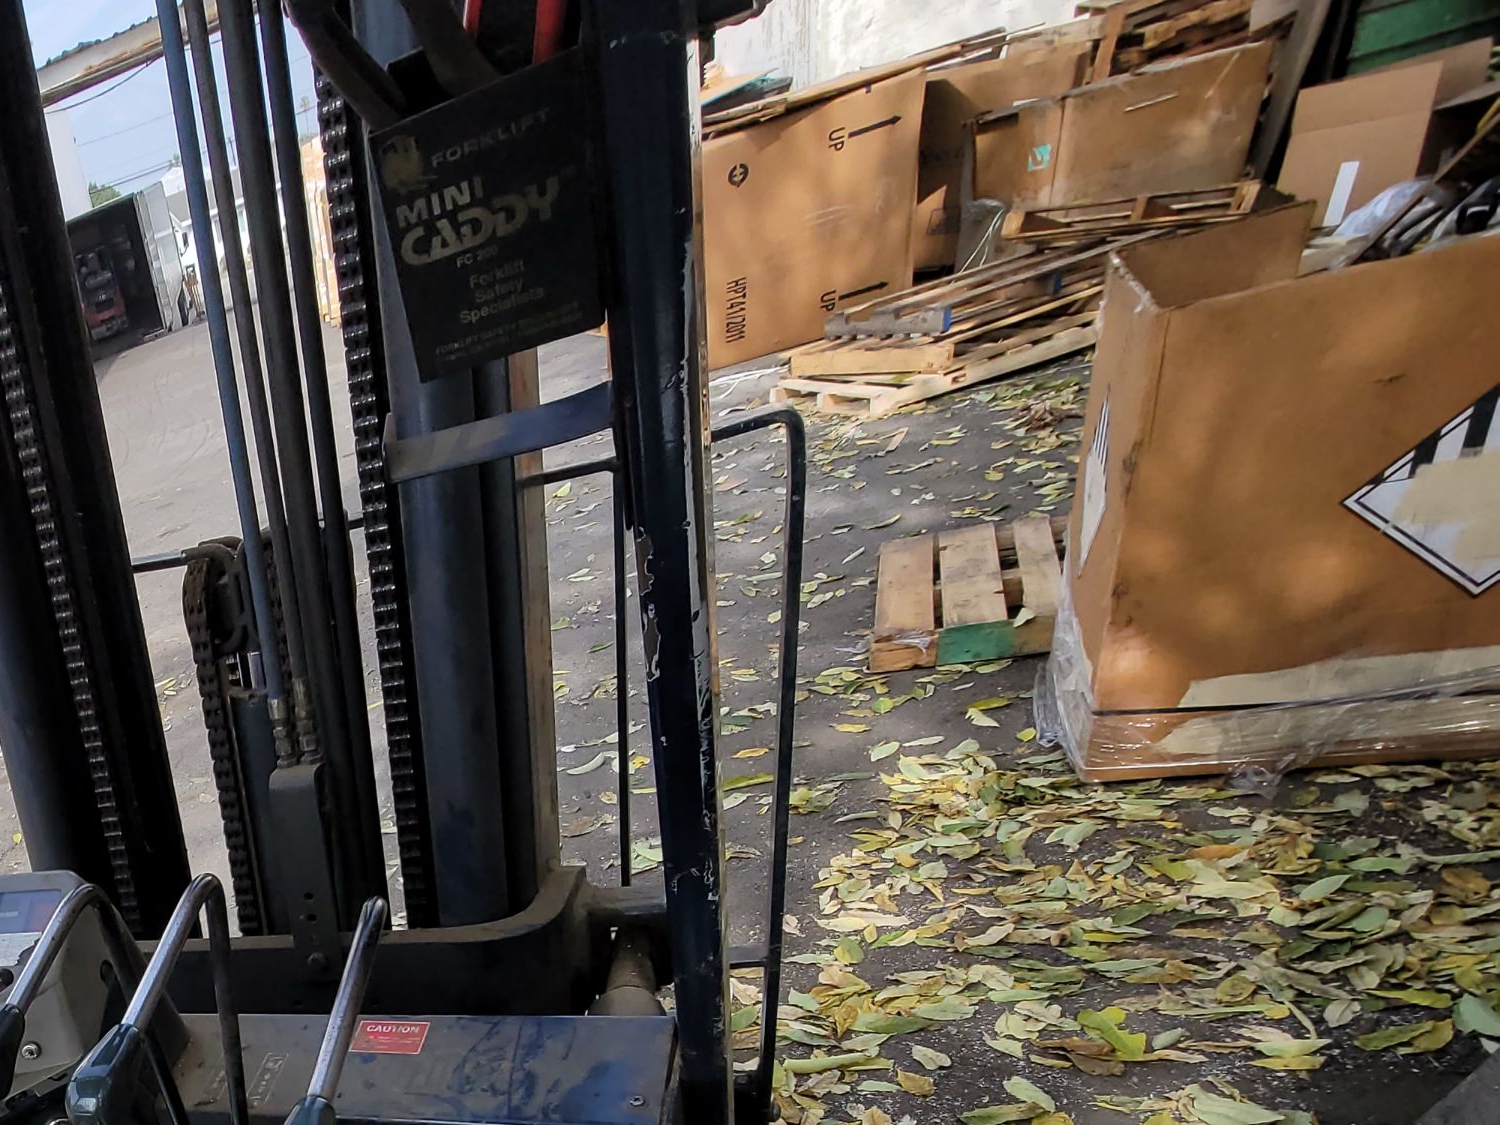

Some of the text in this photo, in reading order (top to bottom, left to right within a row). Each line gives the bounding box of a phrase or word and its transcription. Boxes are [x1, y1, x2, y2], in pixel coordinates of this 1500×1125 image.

[431, 107, 550, 168] FORKLIFT
[828, 127, 845, 152] UP
[396, 176, 484, 229] MINI
[401, 175, 561, 267] CADDY
[725, 276, 748, 344] HPT41/2011
[820, 289, 836, 312] UP
[366, 1024, 420, 1034] CAUTION
